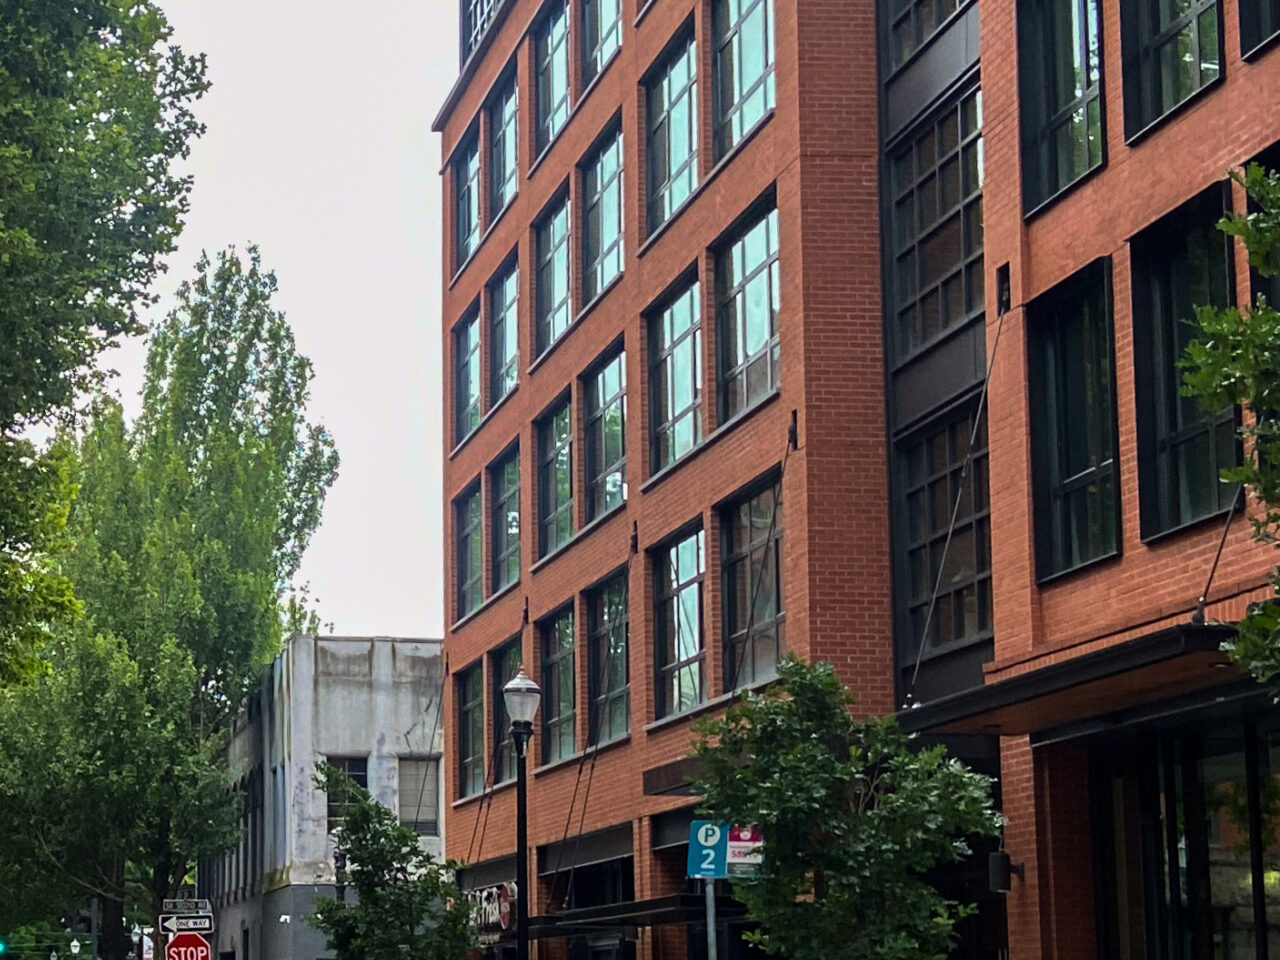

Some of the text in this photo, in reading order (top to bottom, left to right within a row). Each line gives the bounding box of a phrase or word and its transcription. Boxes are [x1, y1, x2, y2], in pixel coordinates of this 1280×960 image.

[704, 828, 715, 842] P
[700, 849, 715, 869] 2
[176, 920, 207, 928] ONE WAY
